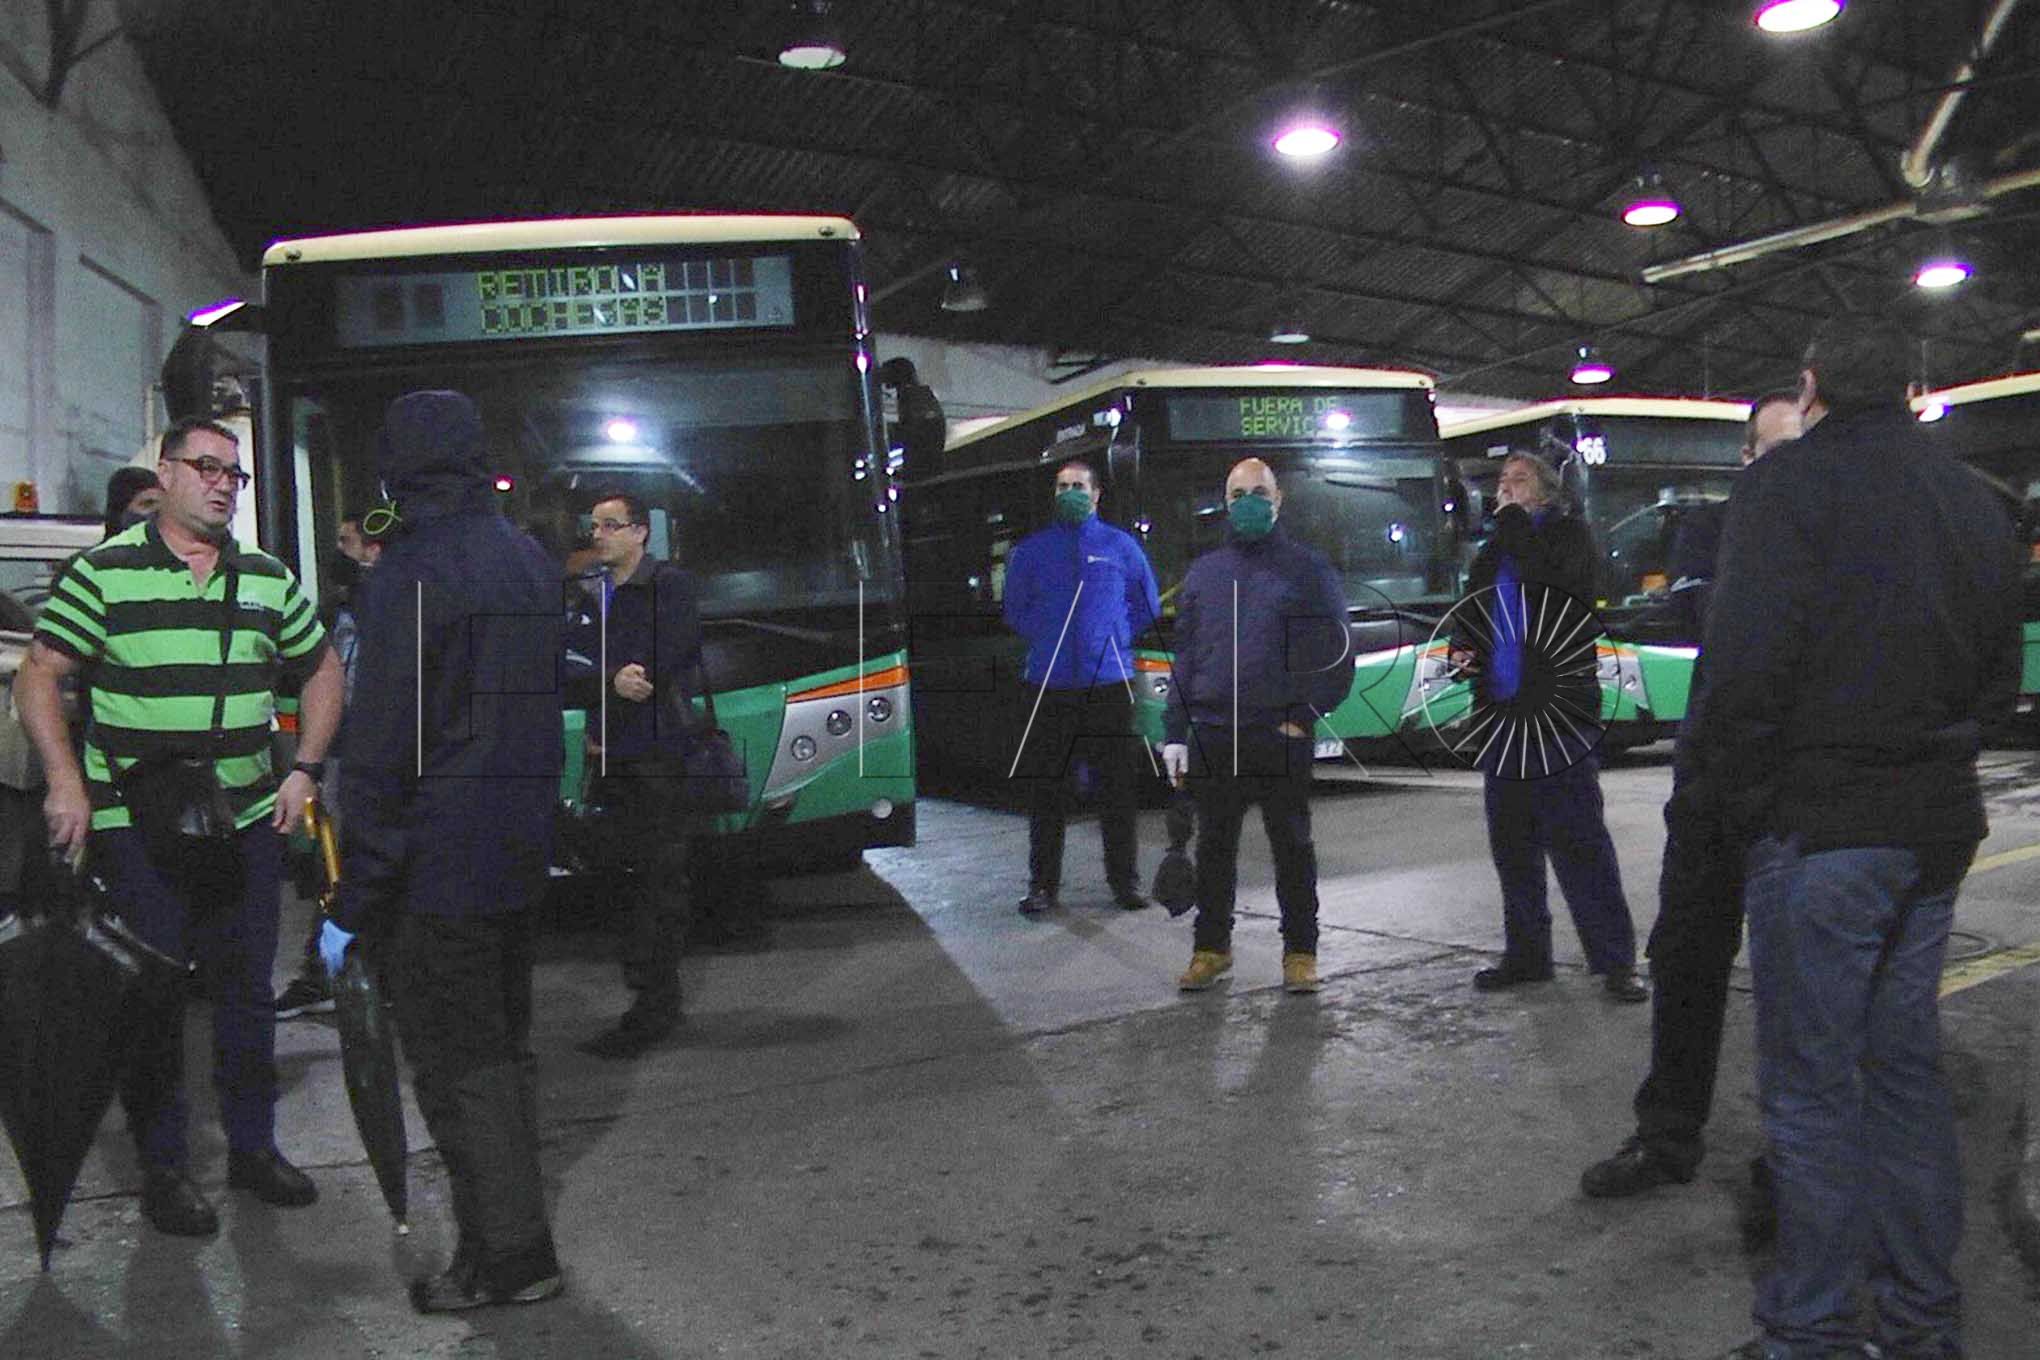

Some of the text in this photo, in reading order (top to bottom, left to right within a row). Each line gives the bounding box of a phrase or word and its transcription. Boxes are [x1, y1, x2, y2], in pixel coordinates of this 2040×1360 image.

[1239, 396, 1338, 415] FUERA DE
[1240, 415, 1338, 436] SERVIC
